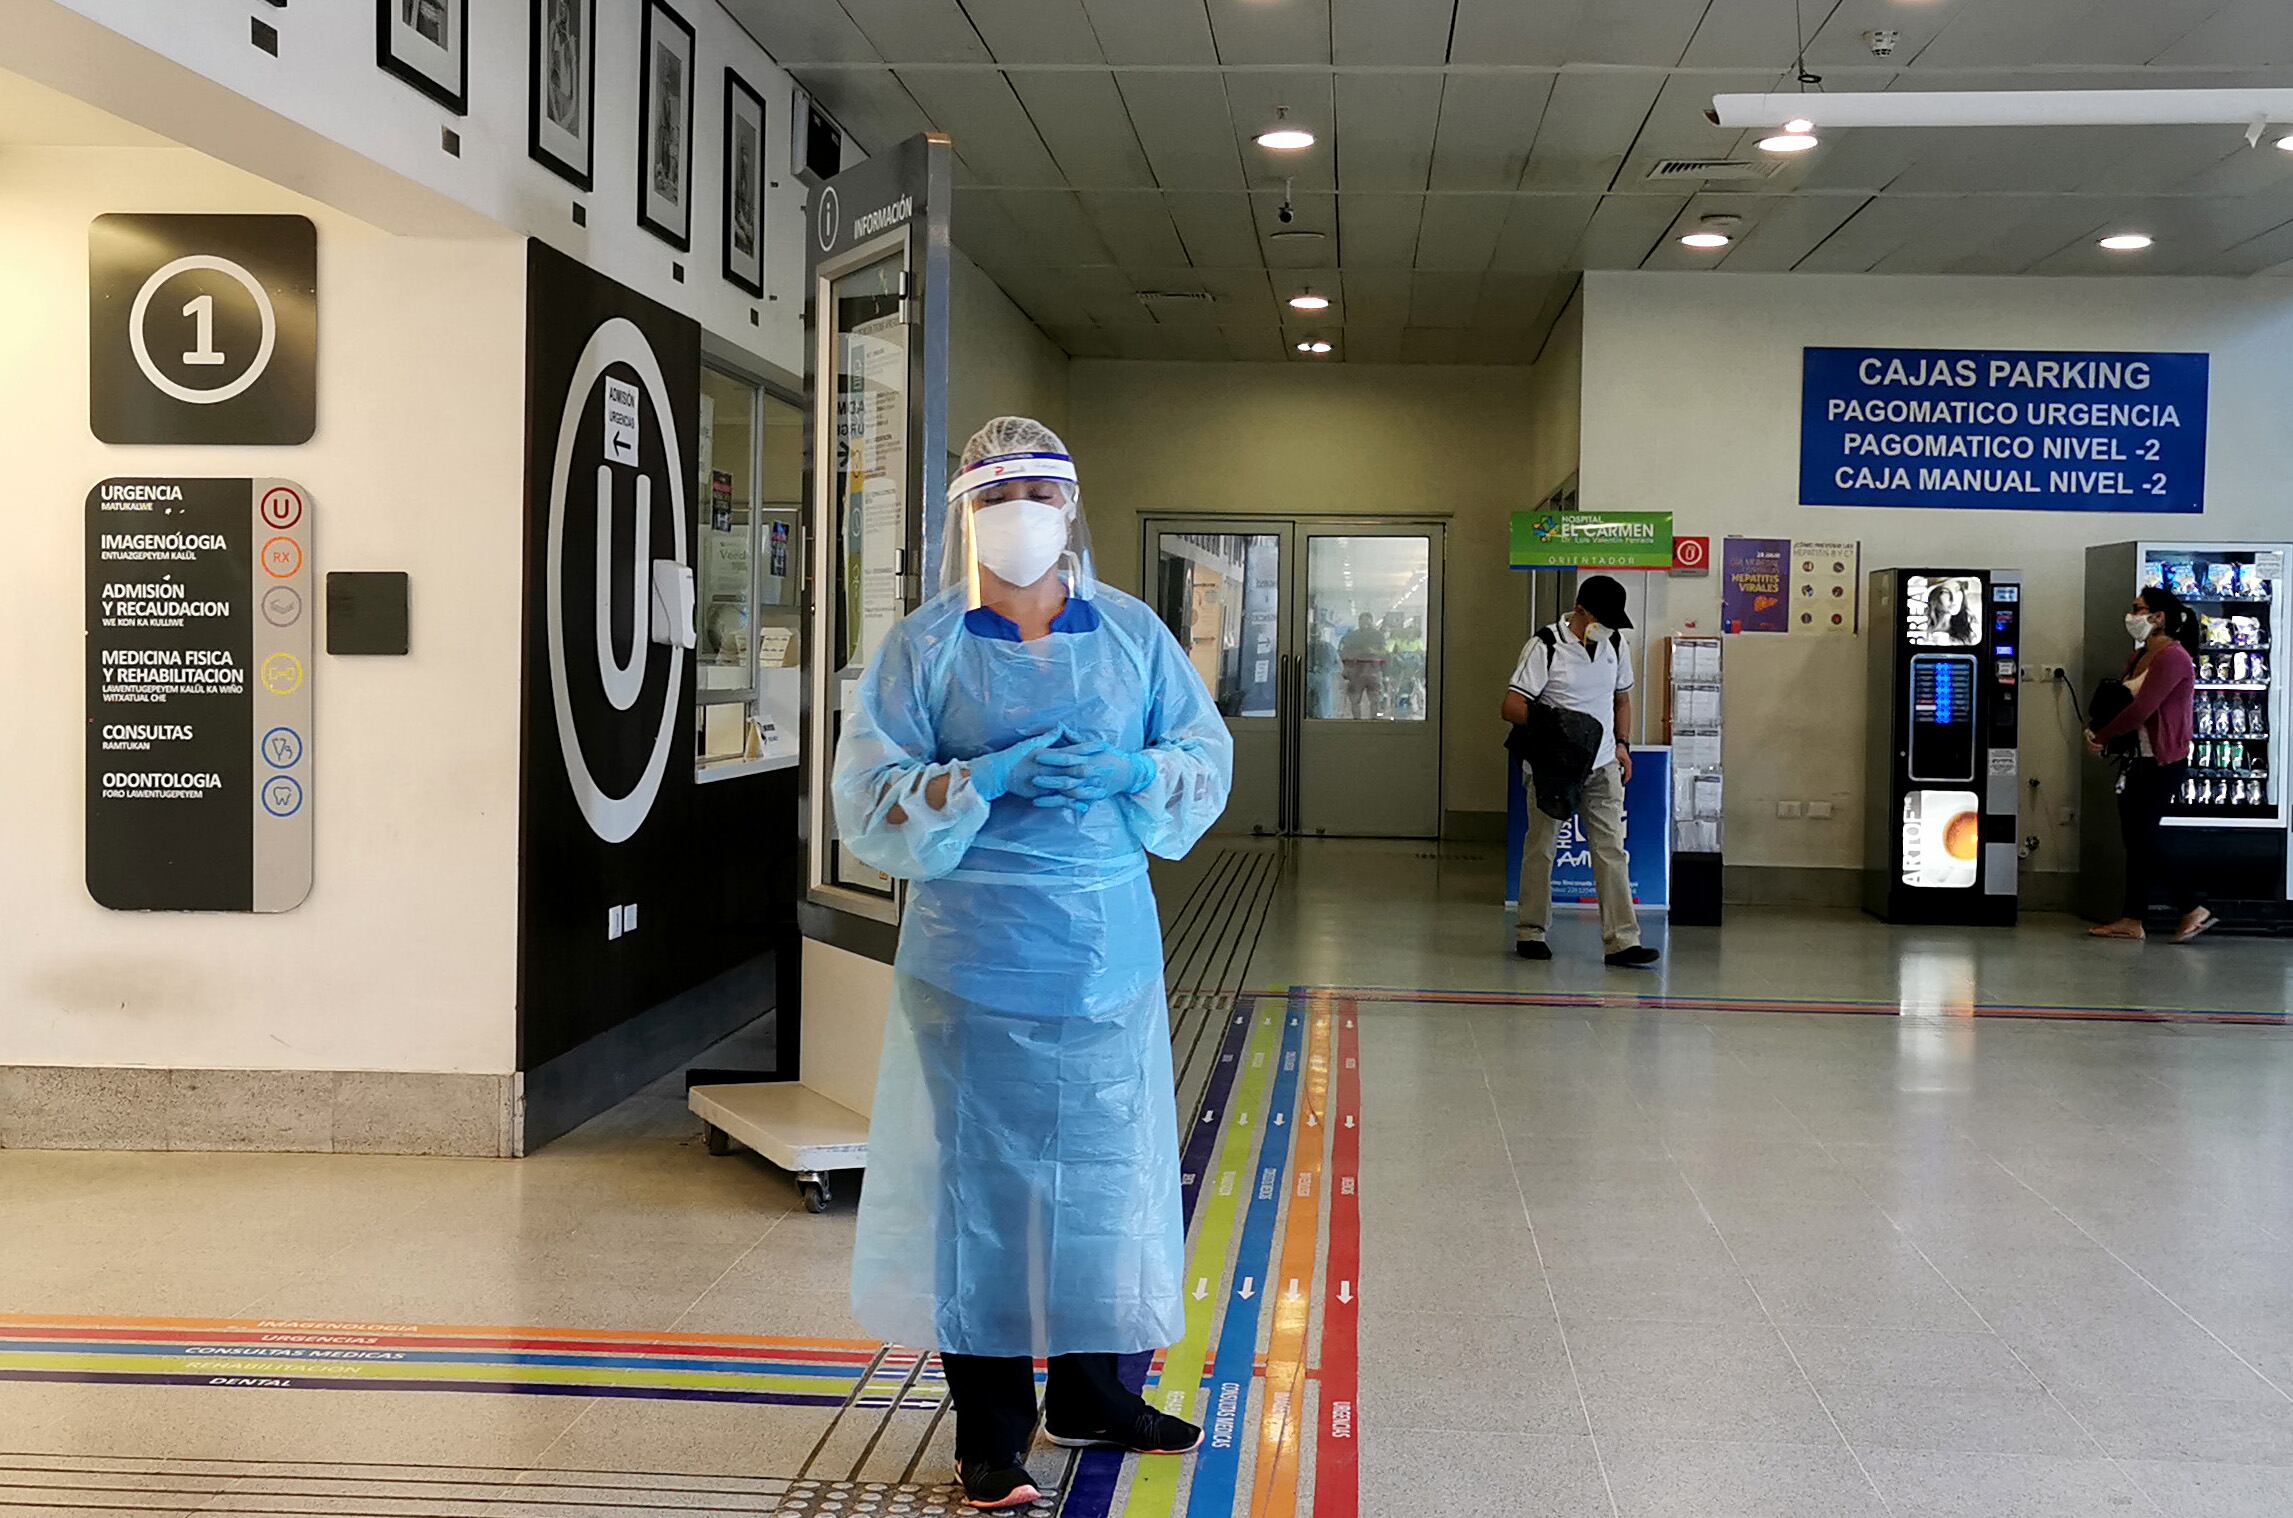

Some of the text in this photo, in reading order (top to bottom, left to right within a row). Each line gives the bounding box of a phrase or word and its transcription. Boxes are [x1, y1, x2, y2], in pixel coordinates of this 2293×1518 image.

[854, 193, 913, 240] INFORMACIÓN
[182, 294, 225, 365] 1
[1859, 358, 2151, 390] CAJAS PARKING
[1828, 398, 2181, 427] PAGOMATICO URGENCIA
[1844, 433, 2160, 461] PAGOMATICO NIVEL -2
[1835, 466, 2167, 495] CAJA MANUAL NIVEL -2
[101, 485, 183, 500] URGENCIA
[1561, 515, 1603, 524] HOSPITAL
[1561, 523, 1655, 537] EL CARMEN
[272, 552, 291, 564] RX
[1548, 556, 1635, 566] ORIENTADOR
[102, 601, 230, 616] Y RECAUDACION
[102, 650, 234, 665] MEDICINA FISICA
[102, 668, 244, 683] Y REHABILITACION
[102, 725, 194, 740] CONSULTAS
[102, 772, 223, 788] ODONTOLOGIA
[257, 1320, 419, 1333] IMAGENOLOGIA
[261, 1334, 380, 1345] URGENCIAS
[185, 1346, 407, 1360] CONSULTAS MEDICAS
[208, 1377, 292, 1387] DENTAL
[1331, 1400, 1351, 1439] URGENCIAS
